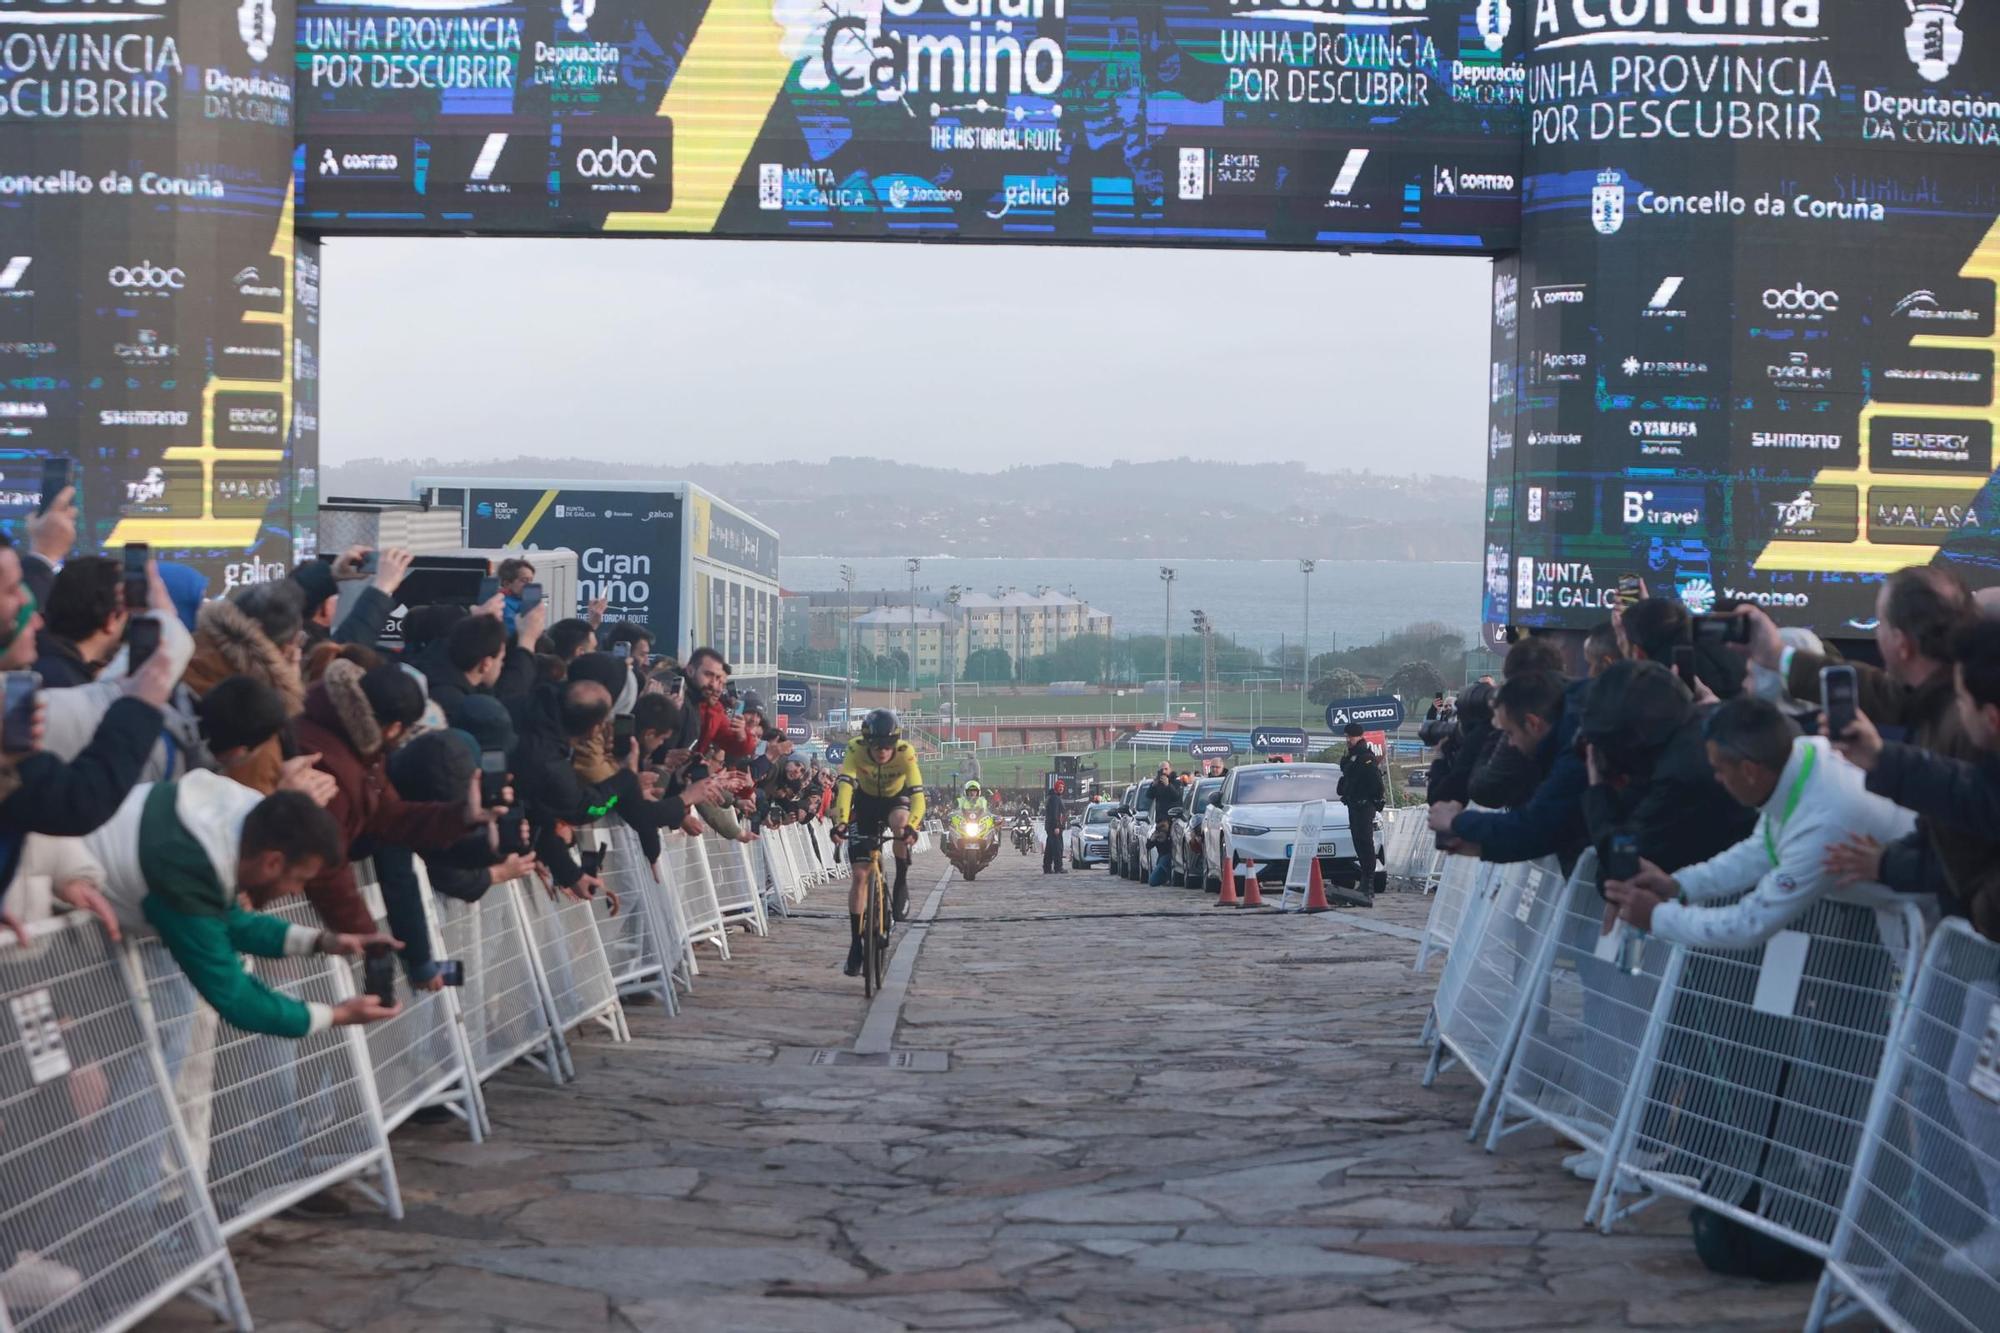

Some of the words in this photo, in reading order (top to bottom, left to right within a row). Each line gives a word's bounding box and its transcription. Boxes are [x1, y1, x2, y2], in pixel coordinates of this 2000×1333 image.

[304, 17, 378, 50] UNHA
[387, 17, 522, 51] PROVINCIA
[0, 33, 182, 74] OVINCIA
[1221, 29, 1295, 64] UNHA
[1303, 32, 1438, 69] PROVINCIA
[311, 55, 364, 88] POR
[371, 55, 512, 89] DESCUBRIR
[1529, 59, 1599, 104] UNHA
[1610, 55, 1837, 97] PROVINCIA
[1229, 69, 1279, 101] POR
[1288, 70, 1429, 106] DESCUBRIR
[1863, 89, 2000, 120] Deputación
[1532, 103, 1580, 146] POR
[1590, 100, 1822, 142] DESCUBRIR
[1862, 117, 1896, 140] DA
[1902, 117, 2000, 146] CORUÑA
[930, 126, 952, 149] THE
[954, 126, 1022, 151] HISTORICAL
[576, 135, 657, 178] adoc
[100, 170, 133, 194] da
[140, 172, 224, 197] Coruña
[787, 168, 836, 185] XUNTA
[785, 189, 805, 206] DE
[992, 180, 1069, 216] galicia
[1637, 190, 1746, 215] Concello
[1754, 192, 1786, 217] da
[1794, 194, 1885, 221] Coruña
[109, 259, 186, 289] adoc
[1762, 282, 1839, 311] adoc
[1752, 432, 1841, 449] SHIMANO
[1892, 433, 1968, 449] BENERGY
[1623, 491, 1644, 523] B
[1648, 508, 1699, 525] travel
[582, 547, 650, 575] Gran
[1537, 563, 1594, 584] XUNTA
[1536, 585, 1554, 606] DE
[1351, 708, 1394, 720] CORTIZO
[1270, 736, 1302, 744] CORTIZO
